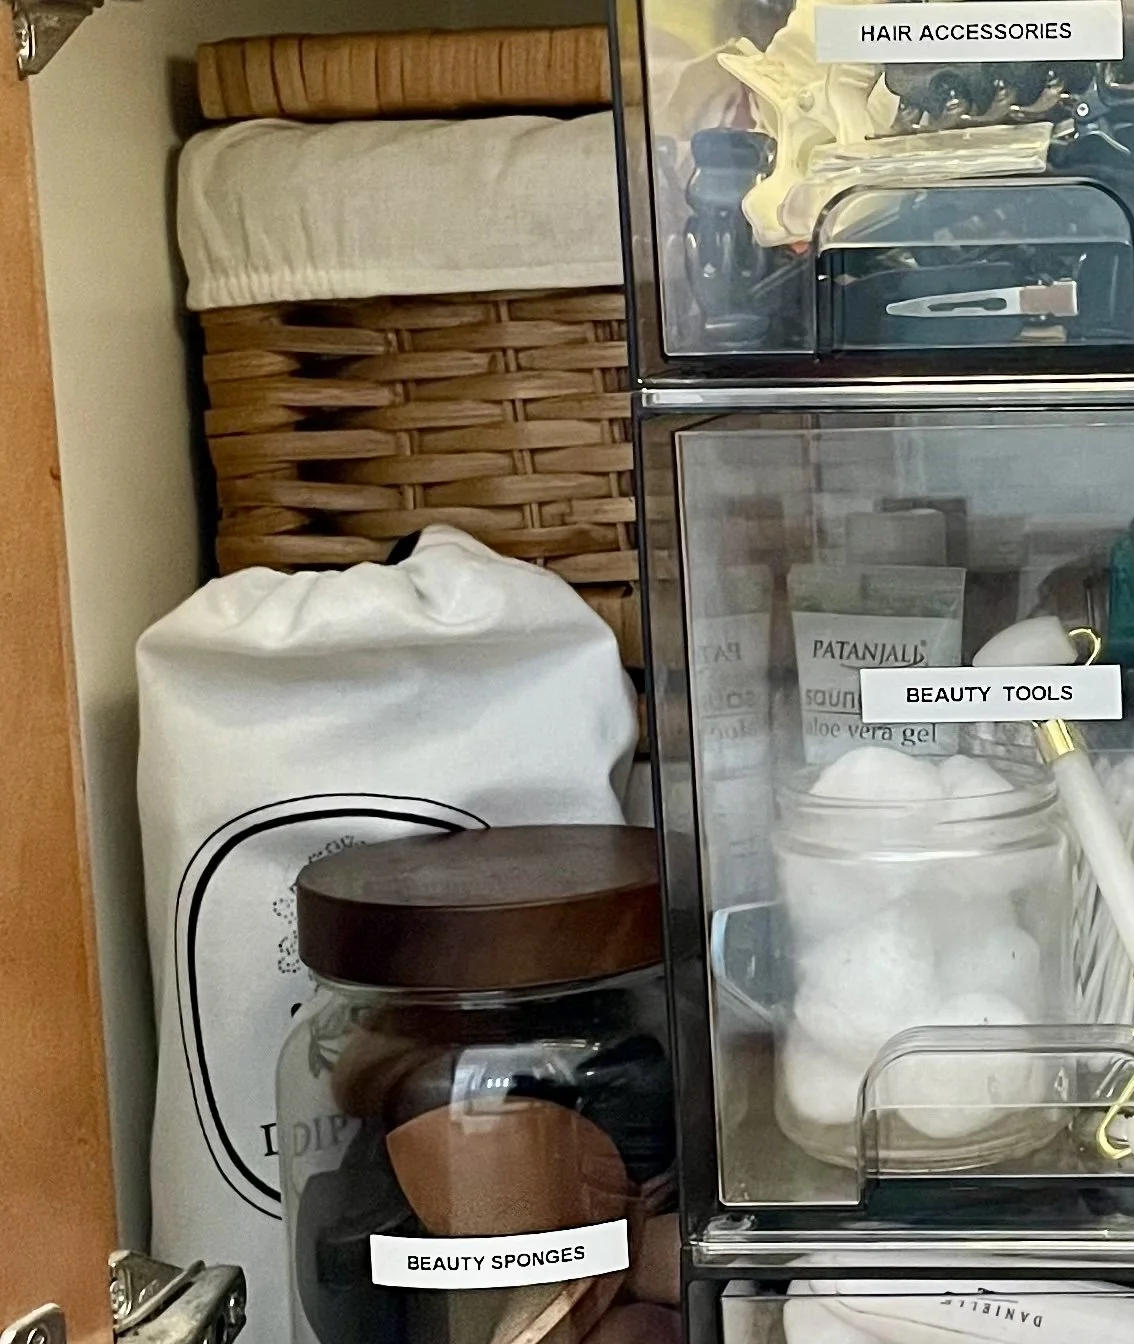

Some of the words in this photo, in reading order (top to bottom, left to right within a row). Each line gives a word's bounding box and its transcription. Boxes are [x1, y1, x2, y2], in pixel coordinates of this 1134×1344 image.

[861, 24, 912, 42] HAIR
[919, 21, 1072, 41] ACCESSORIES
[805, 687, 861, 709] saun
[906, 687, 992, 703] BEAUTY
[1003, 685, 1073, 701] TOOLS
[848, 723, 893, 741] vera
[902, 722, 937, 746] gel
[407, 1255, 485, 1271] BEAUTY
[491, 1245, 585, 1270] SPONGES
